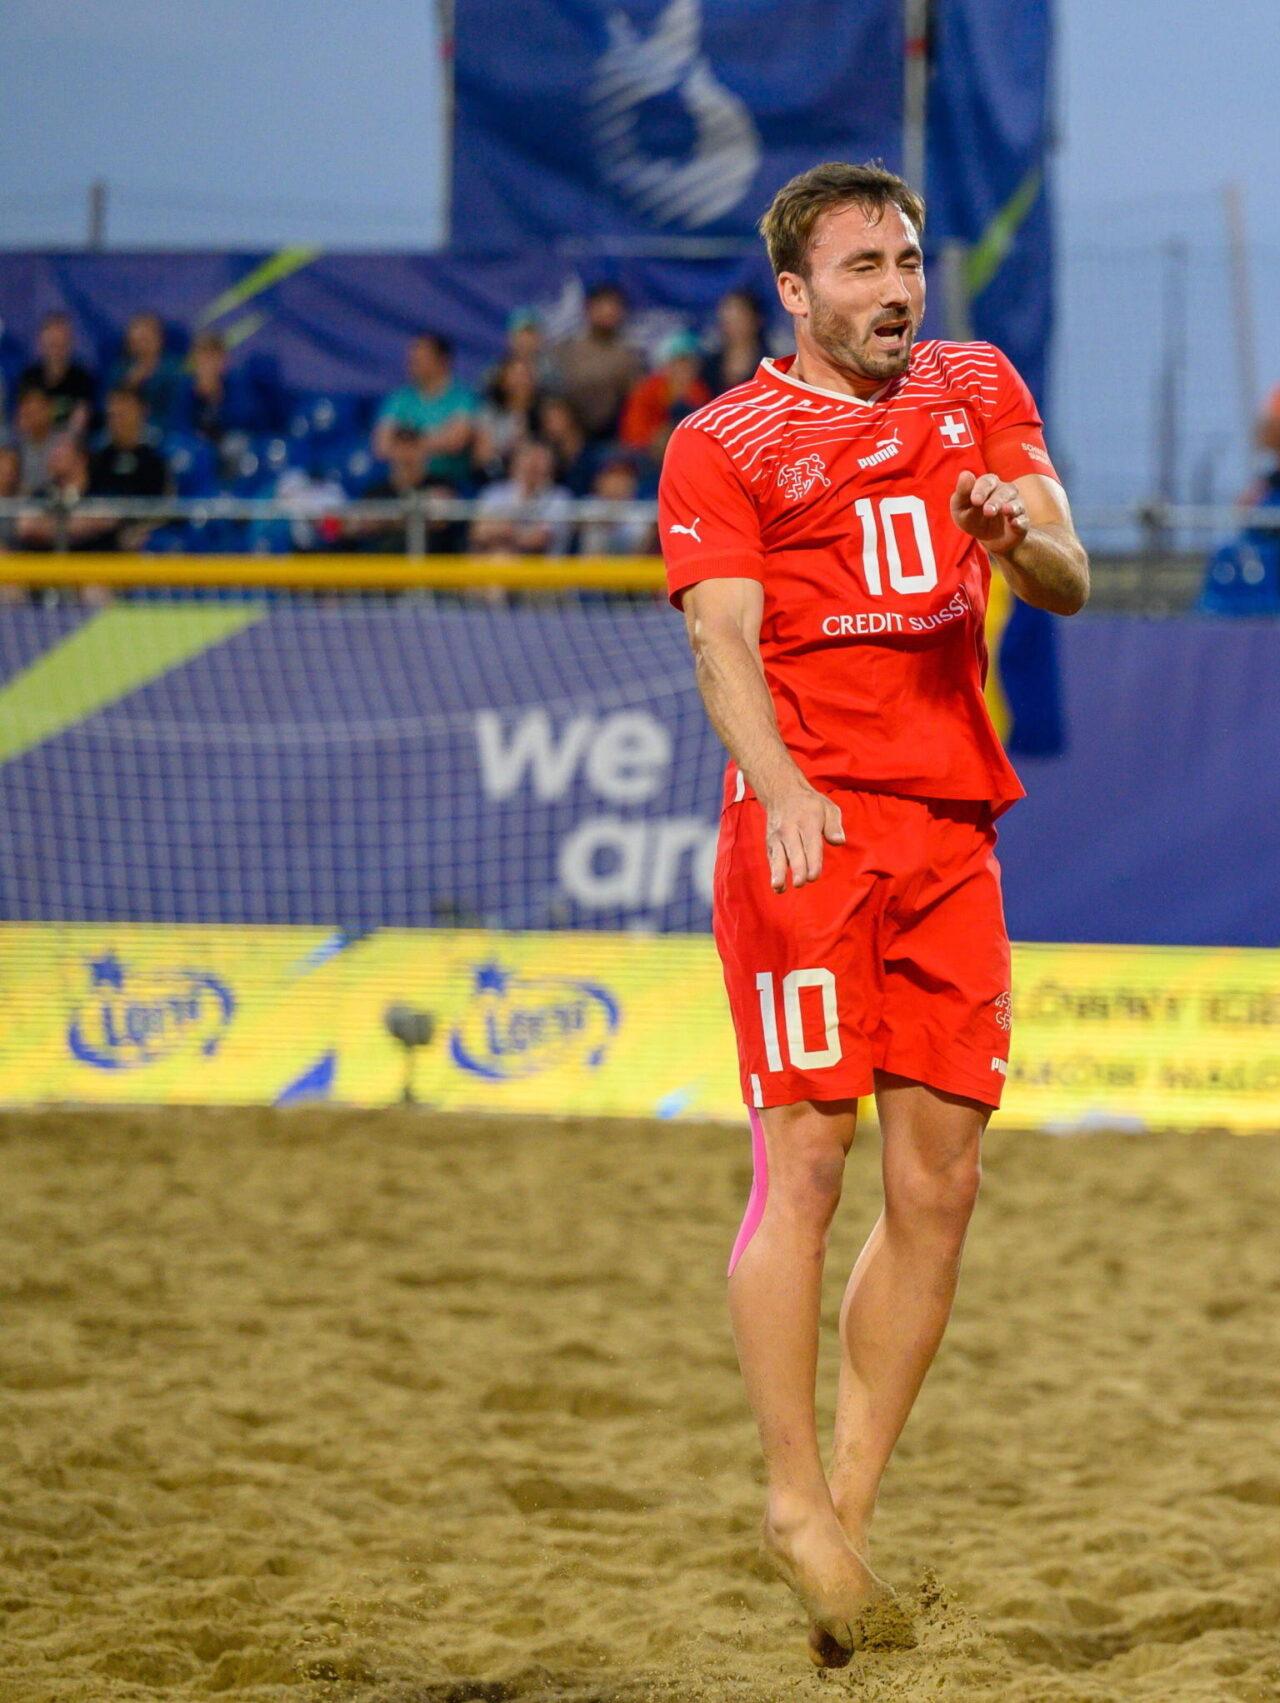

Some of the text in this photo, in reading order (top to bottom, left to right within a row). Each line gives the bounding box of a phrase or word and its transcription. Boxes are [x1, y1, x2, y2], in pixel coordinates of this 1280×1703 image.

[857, 444, 899, 469] PUMA
[854, 495, 939, 596] 10
[822, 592, 969, 636] CREDIT SUISSE
[476, 709, 675, 803] we
[558, 817, 718, 908] ar
[756, 967, 843, 1073] 10
